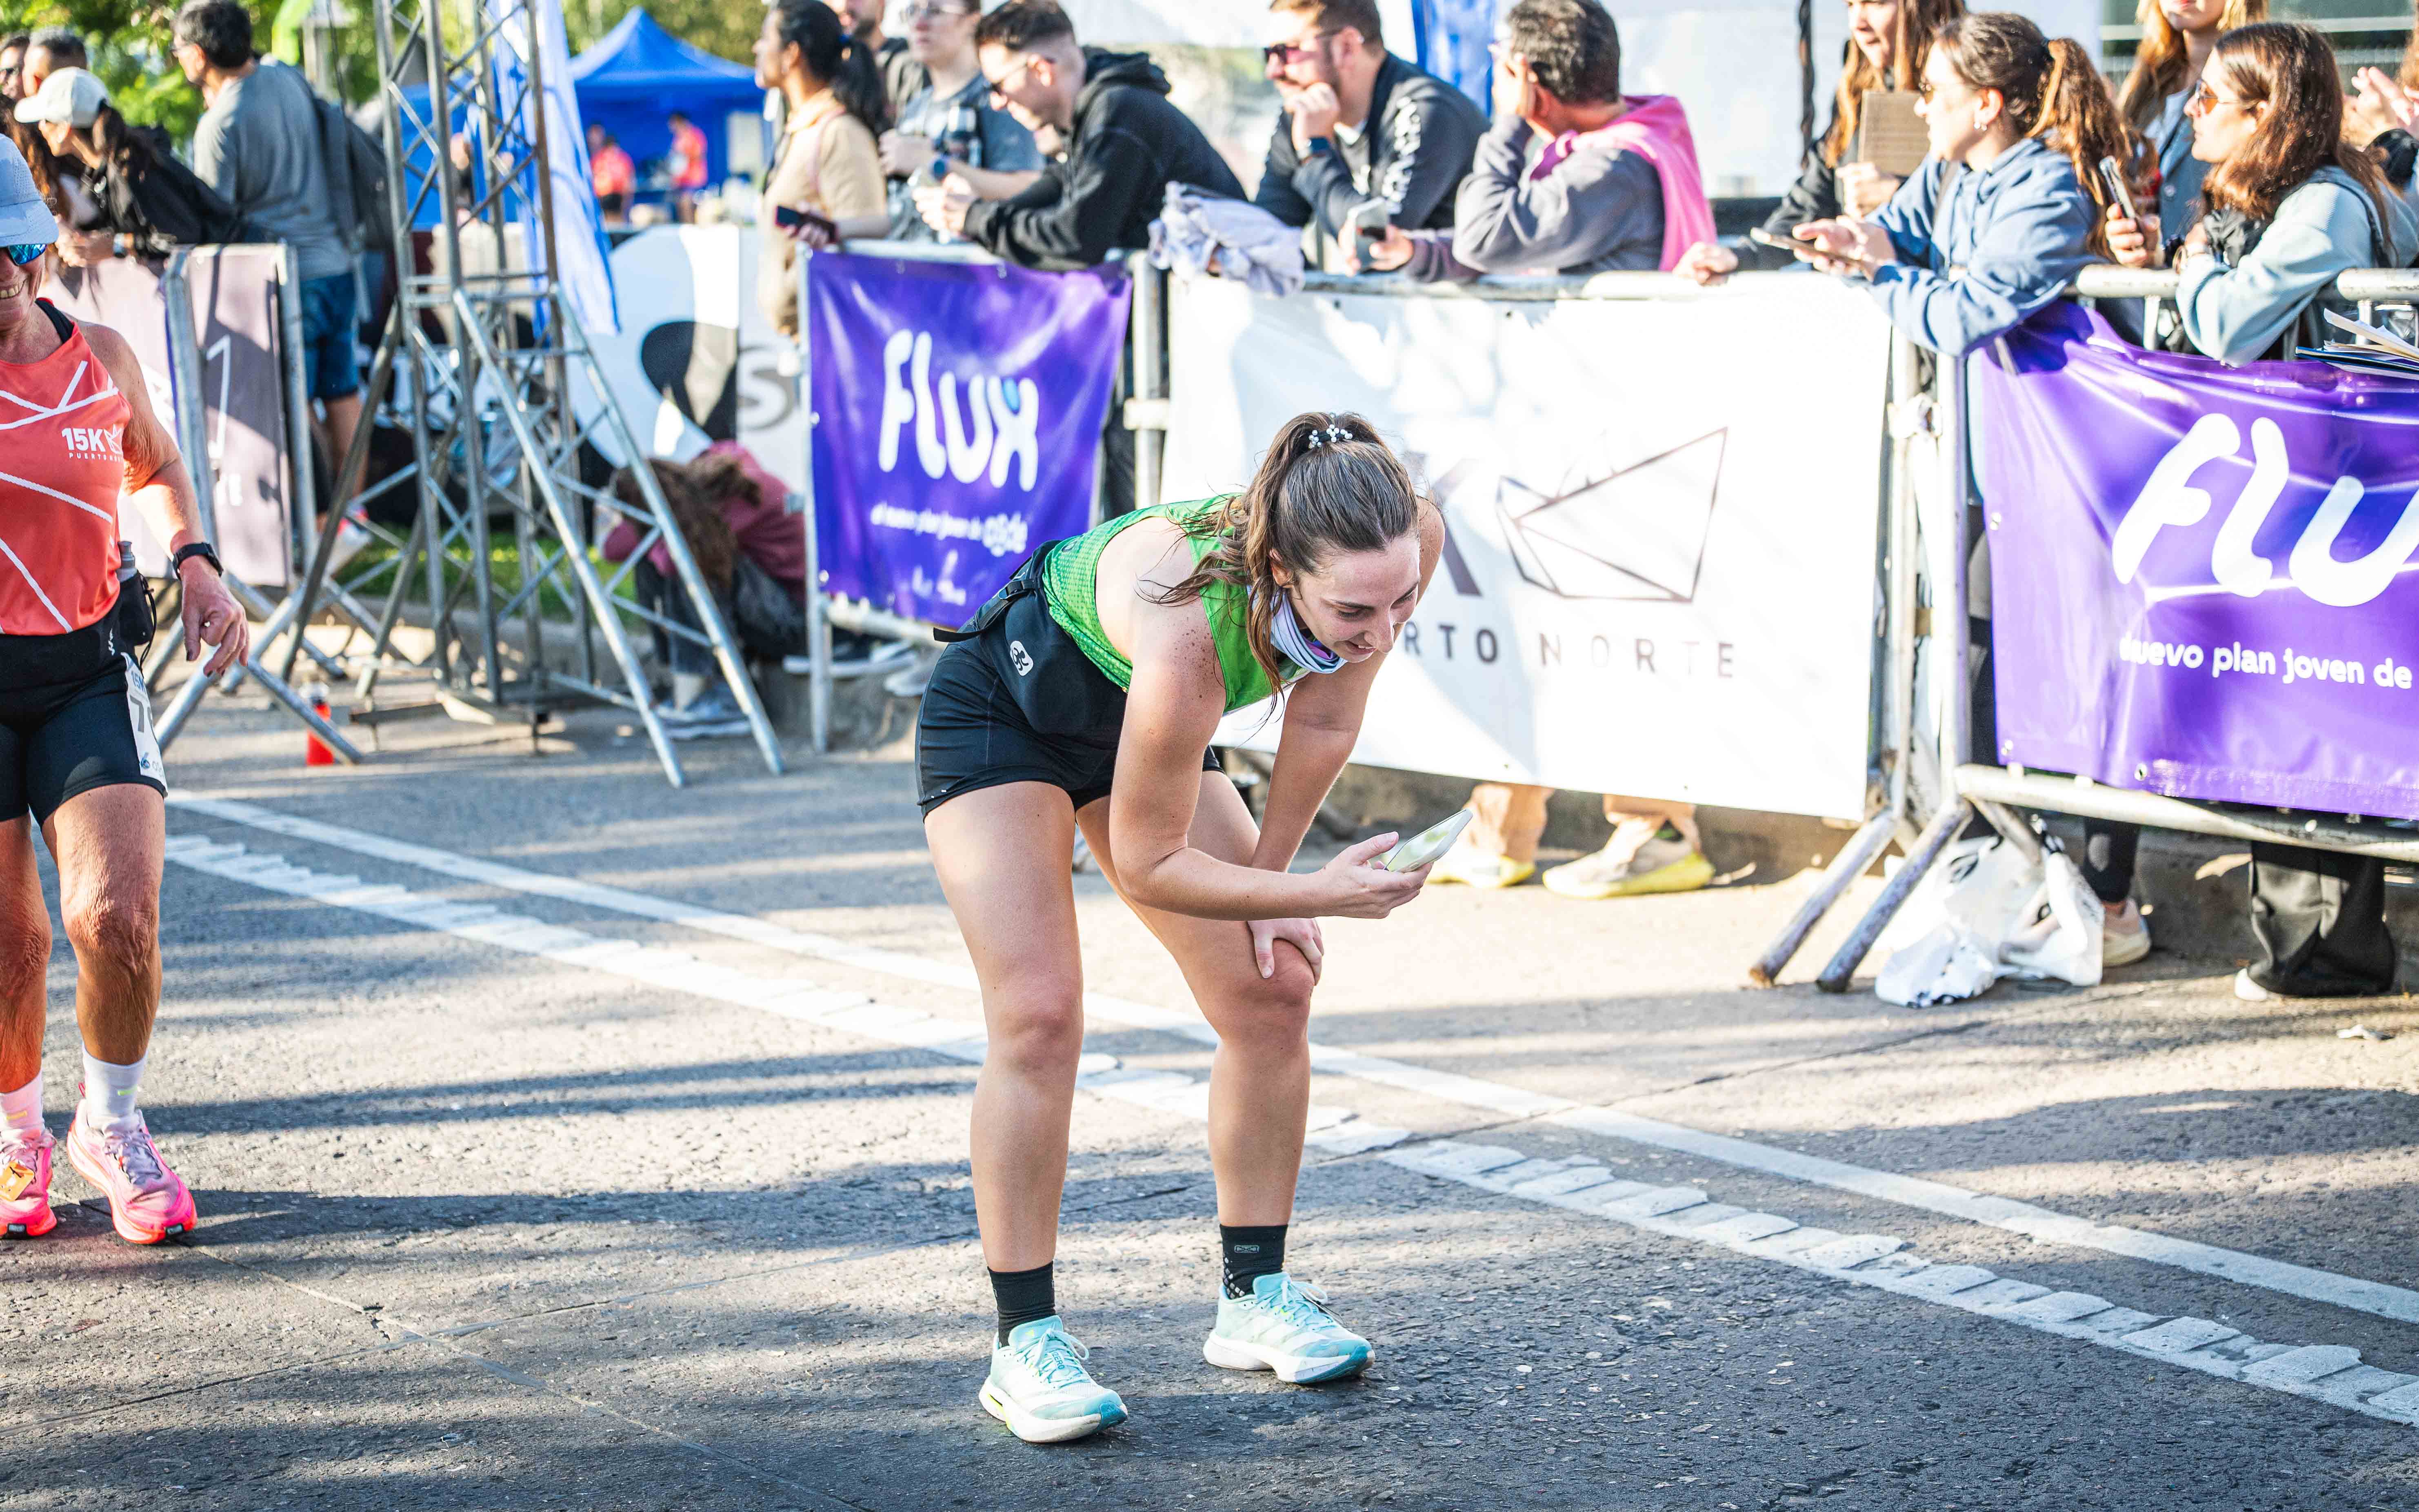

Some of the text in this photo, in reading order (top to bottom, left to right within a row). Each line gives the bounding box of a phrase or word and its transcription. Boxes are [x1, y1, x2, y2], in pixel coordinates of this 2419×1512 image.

[61, 427, 106, 452] 15K
[69, 453, 107, 461] PUERTO
[1403, 621, 1734, 679] RTO NORTE
[2212, 641, 2276, 678] plan
[2282, 648, 2365, 684] joven
[2373, 657, 2412, 690] de
